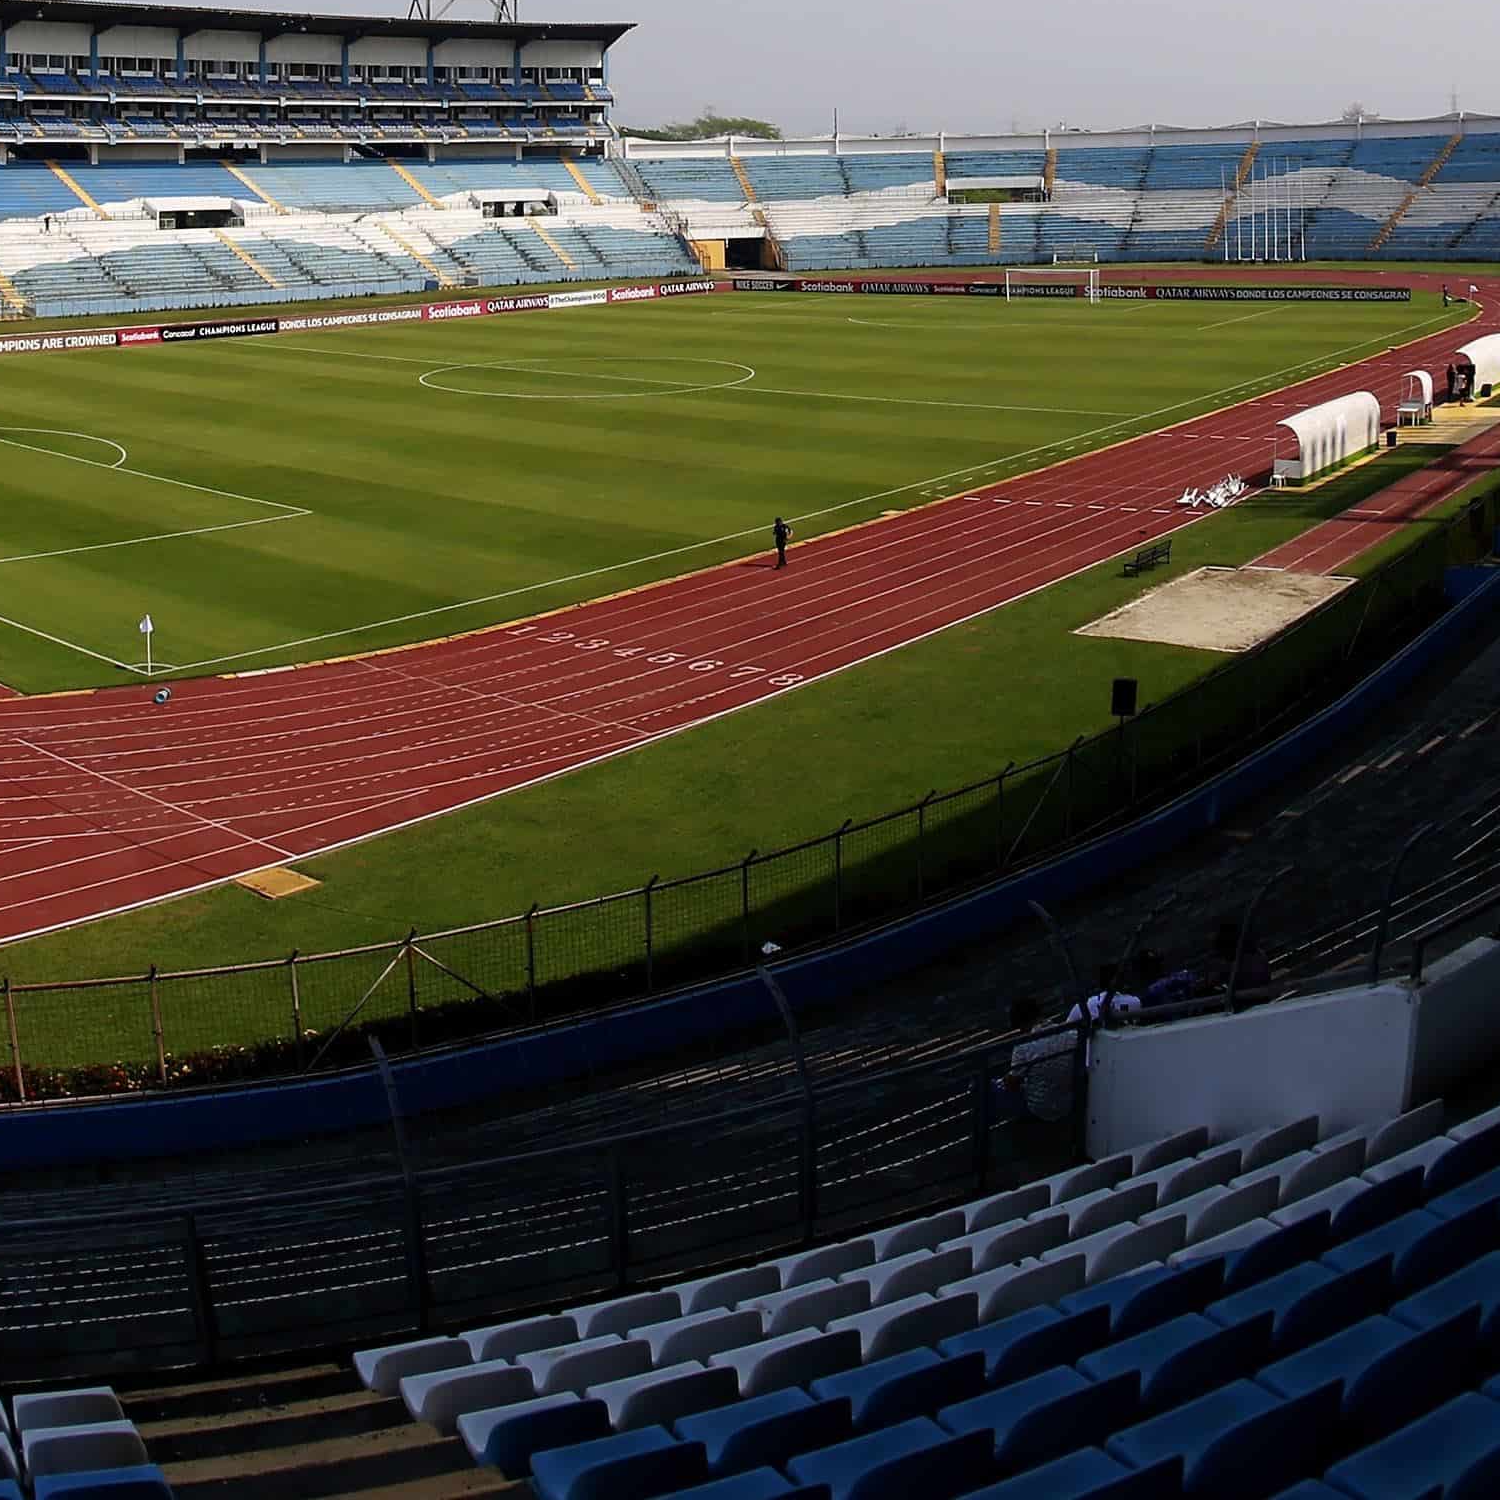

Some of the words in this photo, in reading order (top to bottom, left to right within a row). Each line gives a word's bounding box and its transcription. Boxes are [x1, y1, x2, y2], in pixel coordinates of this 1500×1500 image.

[611, 286, 655, 301] Scotiabank
[660, 283, 685, 296] QATAR
[801, 281, 854, 293] Scotiabank
[861, 283, 890, 294] QATAR
[891, 283, 929, 293] AIRWAYS
[1155, 288, 1191, 299] QATAR
[1194, 289, 1235, 299] AIRWAYS
[1236, 290, 1267, 299] DONDE
[1268, 291, 1285, 299] LOS
[1286, 290, 1340, 299] CAMPEONES
[1341, 291, 1353, 299] SE
[1354, 291, 1410, 299] CONSAGRAN
[428, 303, 482, 319] Scotiabank
[487, 299, 515, 312] QATAR
[515, 297, 549, 309] AIRWAYS
[279, 320, 306, 330] DONDE
[308, 317, 322, 328] LOS
[323, 314, 368, 327] CAMPEONES
[368, 313, 378, 323] SE
[378, 308, 422, 321] CONSAGRAN
[199, 324, 246, 336] CHAMPIONS
[247, 321, 277, 333] LEAGUE
[42, 337, 63, 349] ARE
[65, 333, 116, 348] CROWNED
[121, 331, 160, 342] Scotiabank
[505, 625, 538, 636] 1
[536, 631, 575, 643] 2
[574, 638, 610, 650] 3
[613, 646, 645, 658] 4
[647, 651, 689, 664] 5
[688, 659, 725, 672] 6
[728, 666, 767, 679] 7
[768, 673, 804, 687] 8
